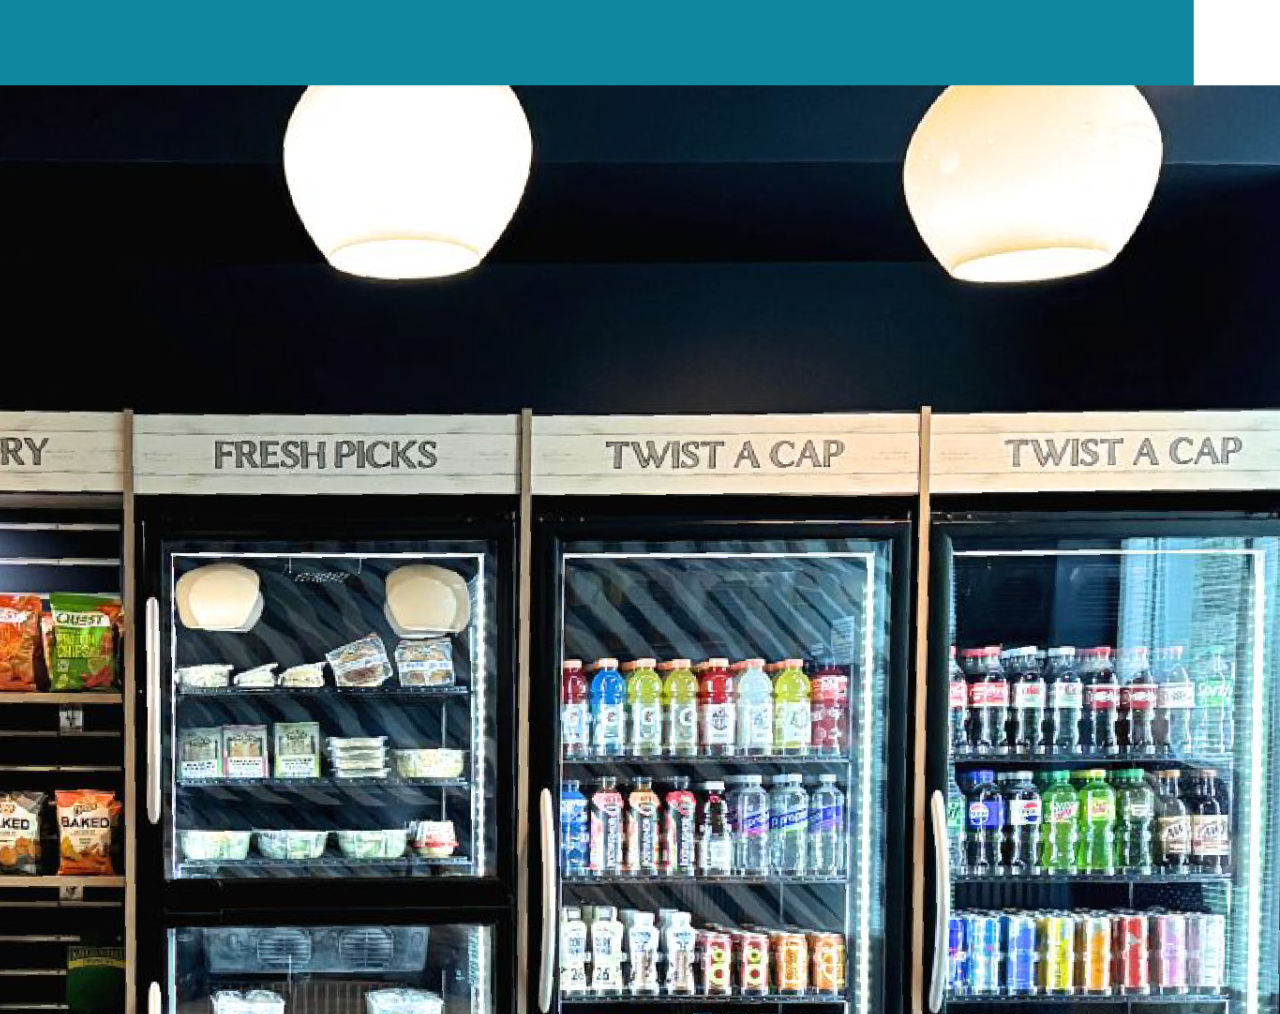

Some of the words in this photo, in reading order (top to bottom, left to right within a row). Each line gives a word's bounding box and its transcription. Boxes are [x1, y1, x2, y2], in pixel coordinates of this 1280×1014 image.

[215, 440, 327, 470] FRESH
[333, 440, 438, 470] PICKS
[605, 440, 725, 470] TWIST
[734, 440, 761, 469] A
[770, 440, 845, 469] CAP
[1004, 438, 1128, 468] TWIST
[1133, 438, 1160, 466] A
[1168, 438, 1244, 466] CAP
[56, 612, 105, 626] QUEST
[61, 816, 110, 828] BAKED
[596, 967, 610, 981] 26
